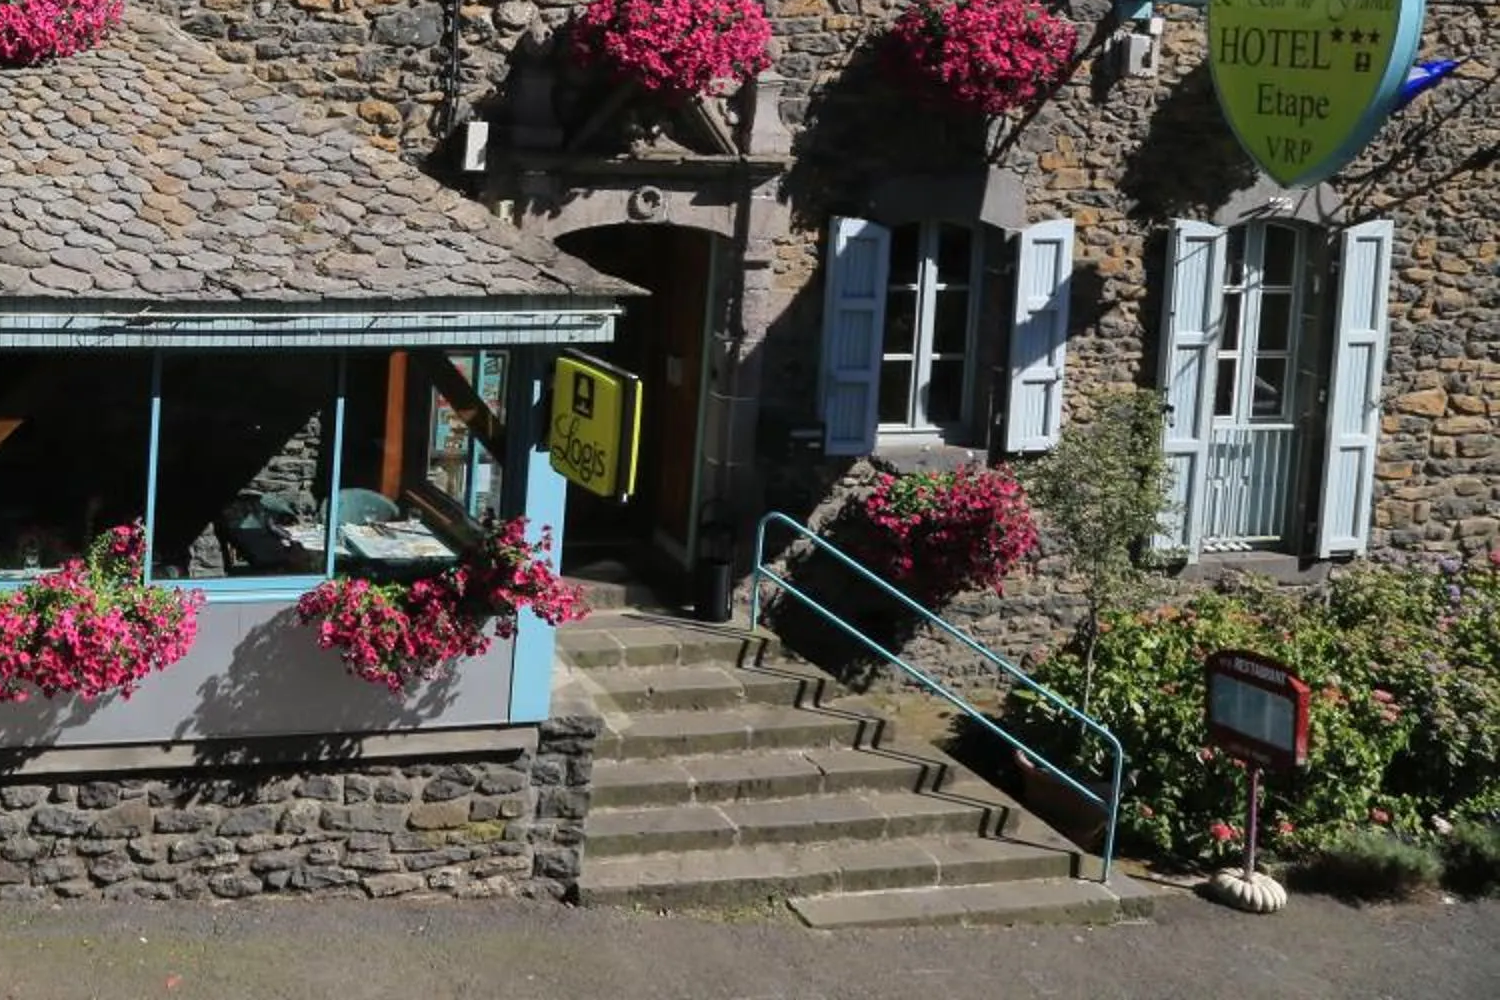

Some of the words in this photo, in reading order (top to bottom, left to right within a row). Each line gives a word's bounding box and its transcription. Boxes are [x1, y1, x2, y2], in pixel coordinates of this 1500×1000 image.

[1218, 27, 1331, 70] HOTEL
[1257, 83, 1330, 128] Etape
[1265, 135, 1314, 165] VRP
[550, 412, 606, 484] Logis
